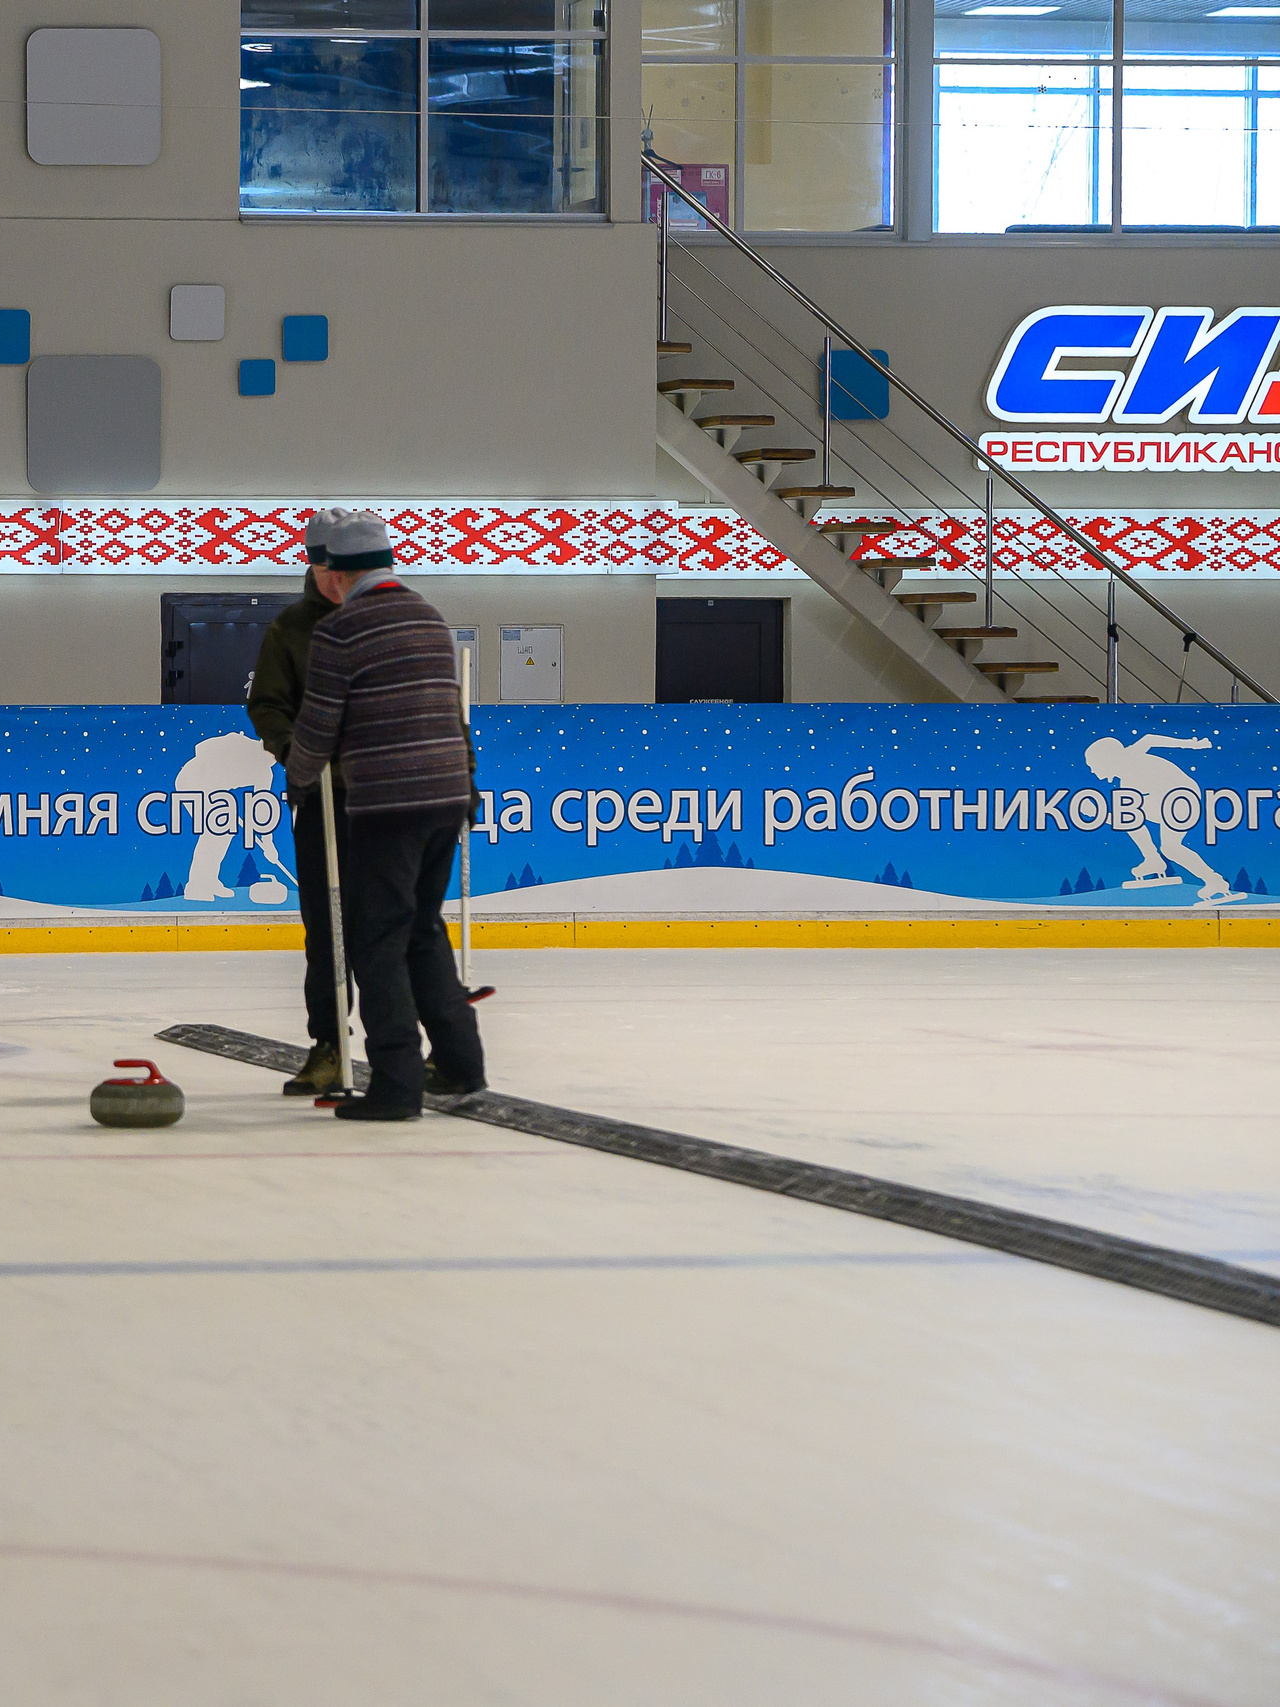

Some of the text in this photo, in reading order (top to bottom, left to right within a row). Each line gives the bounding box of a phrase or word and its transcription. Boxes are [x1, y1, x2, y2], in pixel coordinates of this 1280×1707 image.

[992, 311, 1280, 418] СИ
[986, 441, 1280, 463] РЕСПУБЛИКАН
[551, 789, 742, 846] среди
[764, 771, 1146, 846] работников
[1161, 789, 1280, 845] орг
